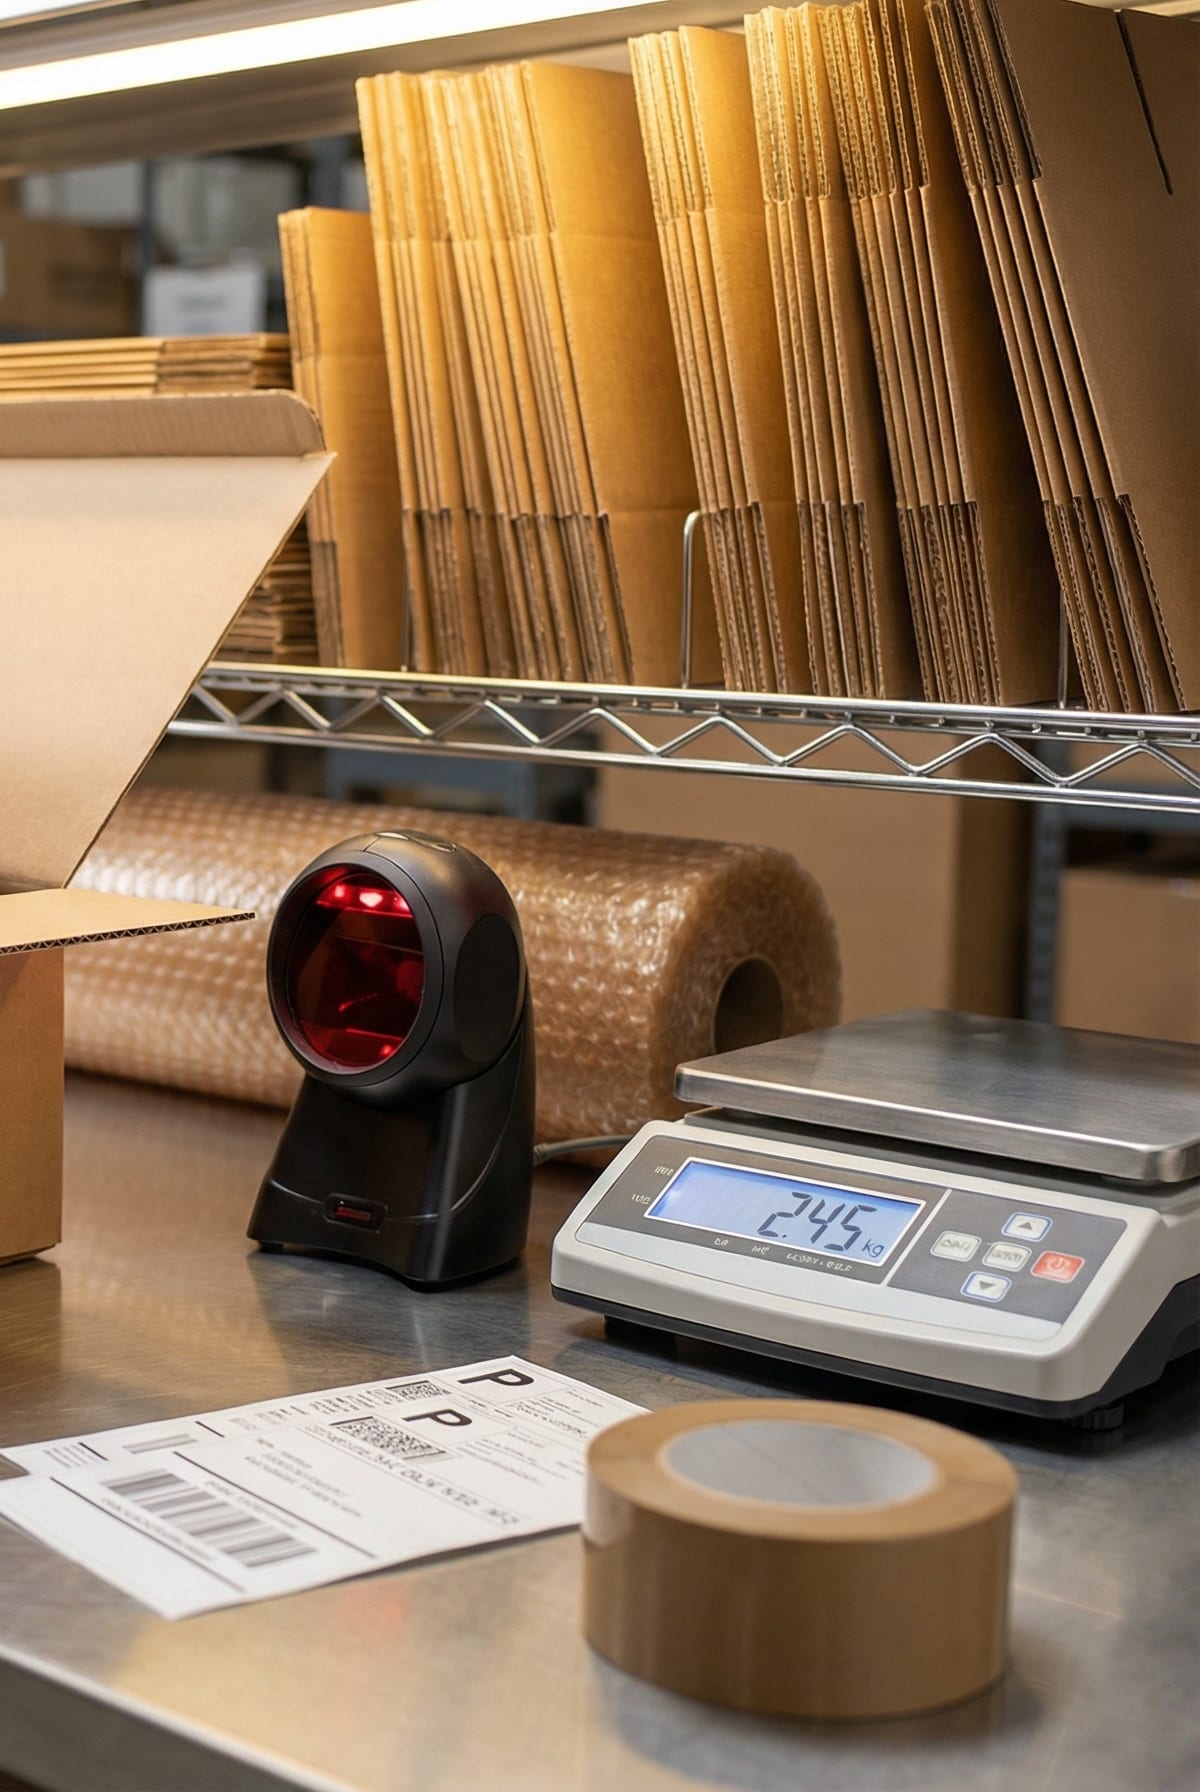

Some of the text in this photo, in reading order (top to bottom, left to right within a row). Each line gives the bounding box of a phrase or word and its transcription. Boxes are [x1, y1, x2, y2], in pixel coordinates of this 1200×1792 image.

[757, 1191, 885, 1258] 2.45 kg
[457, 1368, 535, 1387] P
[400, 1408, 473, 1427] P
